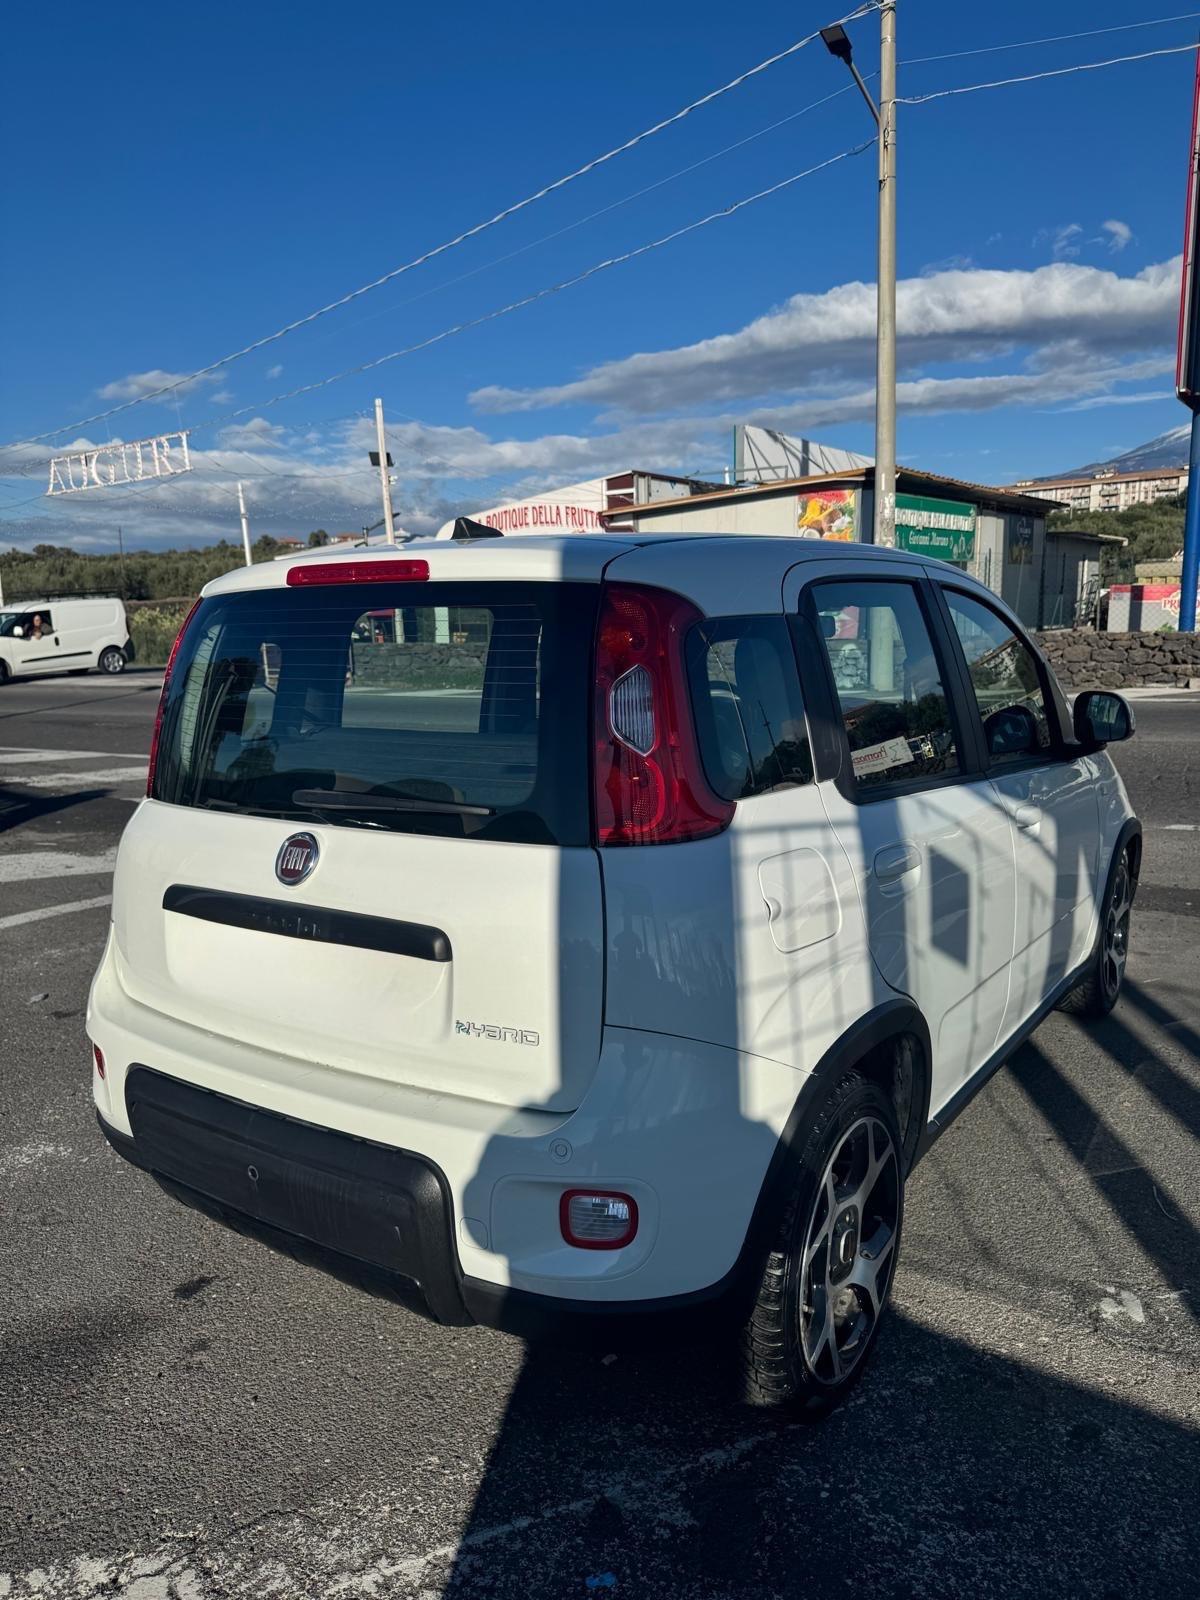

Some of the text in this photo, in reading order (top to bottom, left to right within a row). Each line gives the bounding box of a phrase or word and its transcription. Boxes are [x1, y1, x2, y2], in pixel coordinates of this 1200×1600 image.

[47, 432, 191, 495] AUGURI
[486, 505, 601, 530] BOUTIQUE DELLA FRUTTA
[282, 847, 311, 870] FIAT
[455, 1019, 540, 1047] HYBRID
